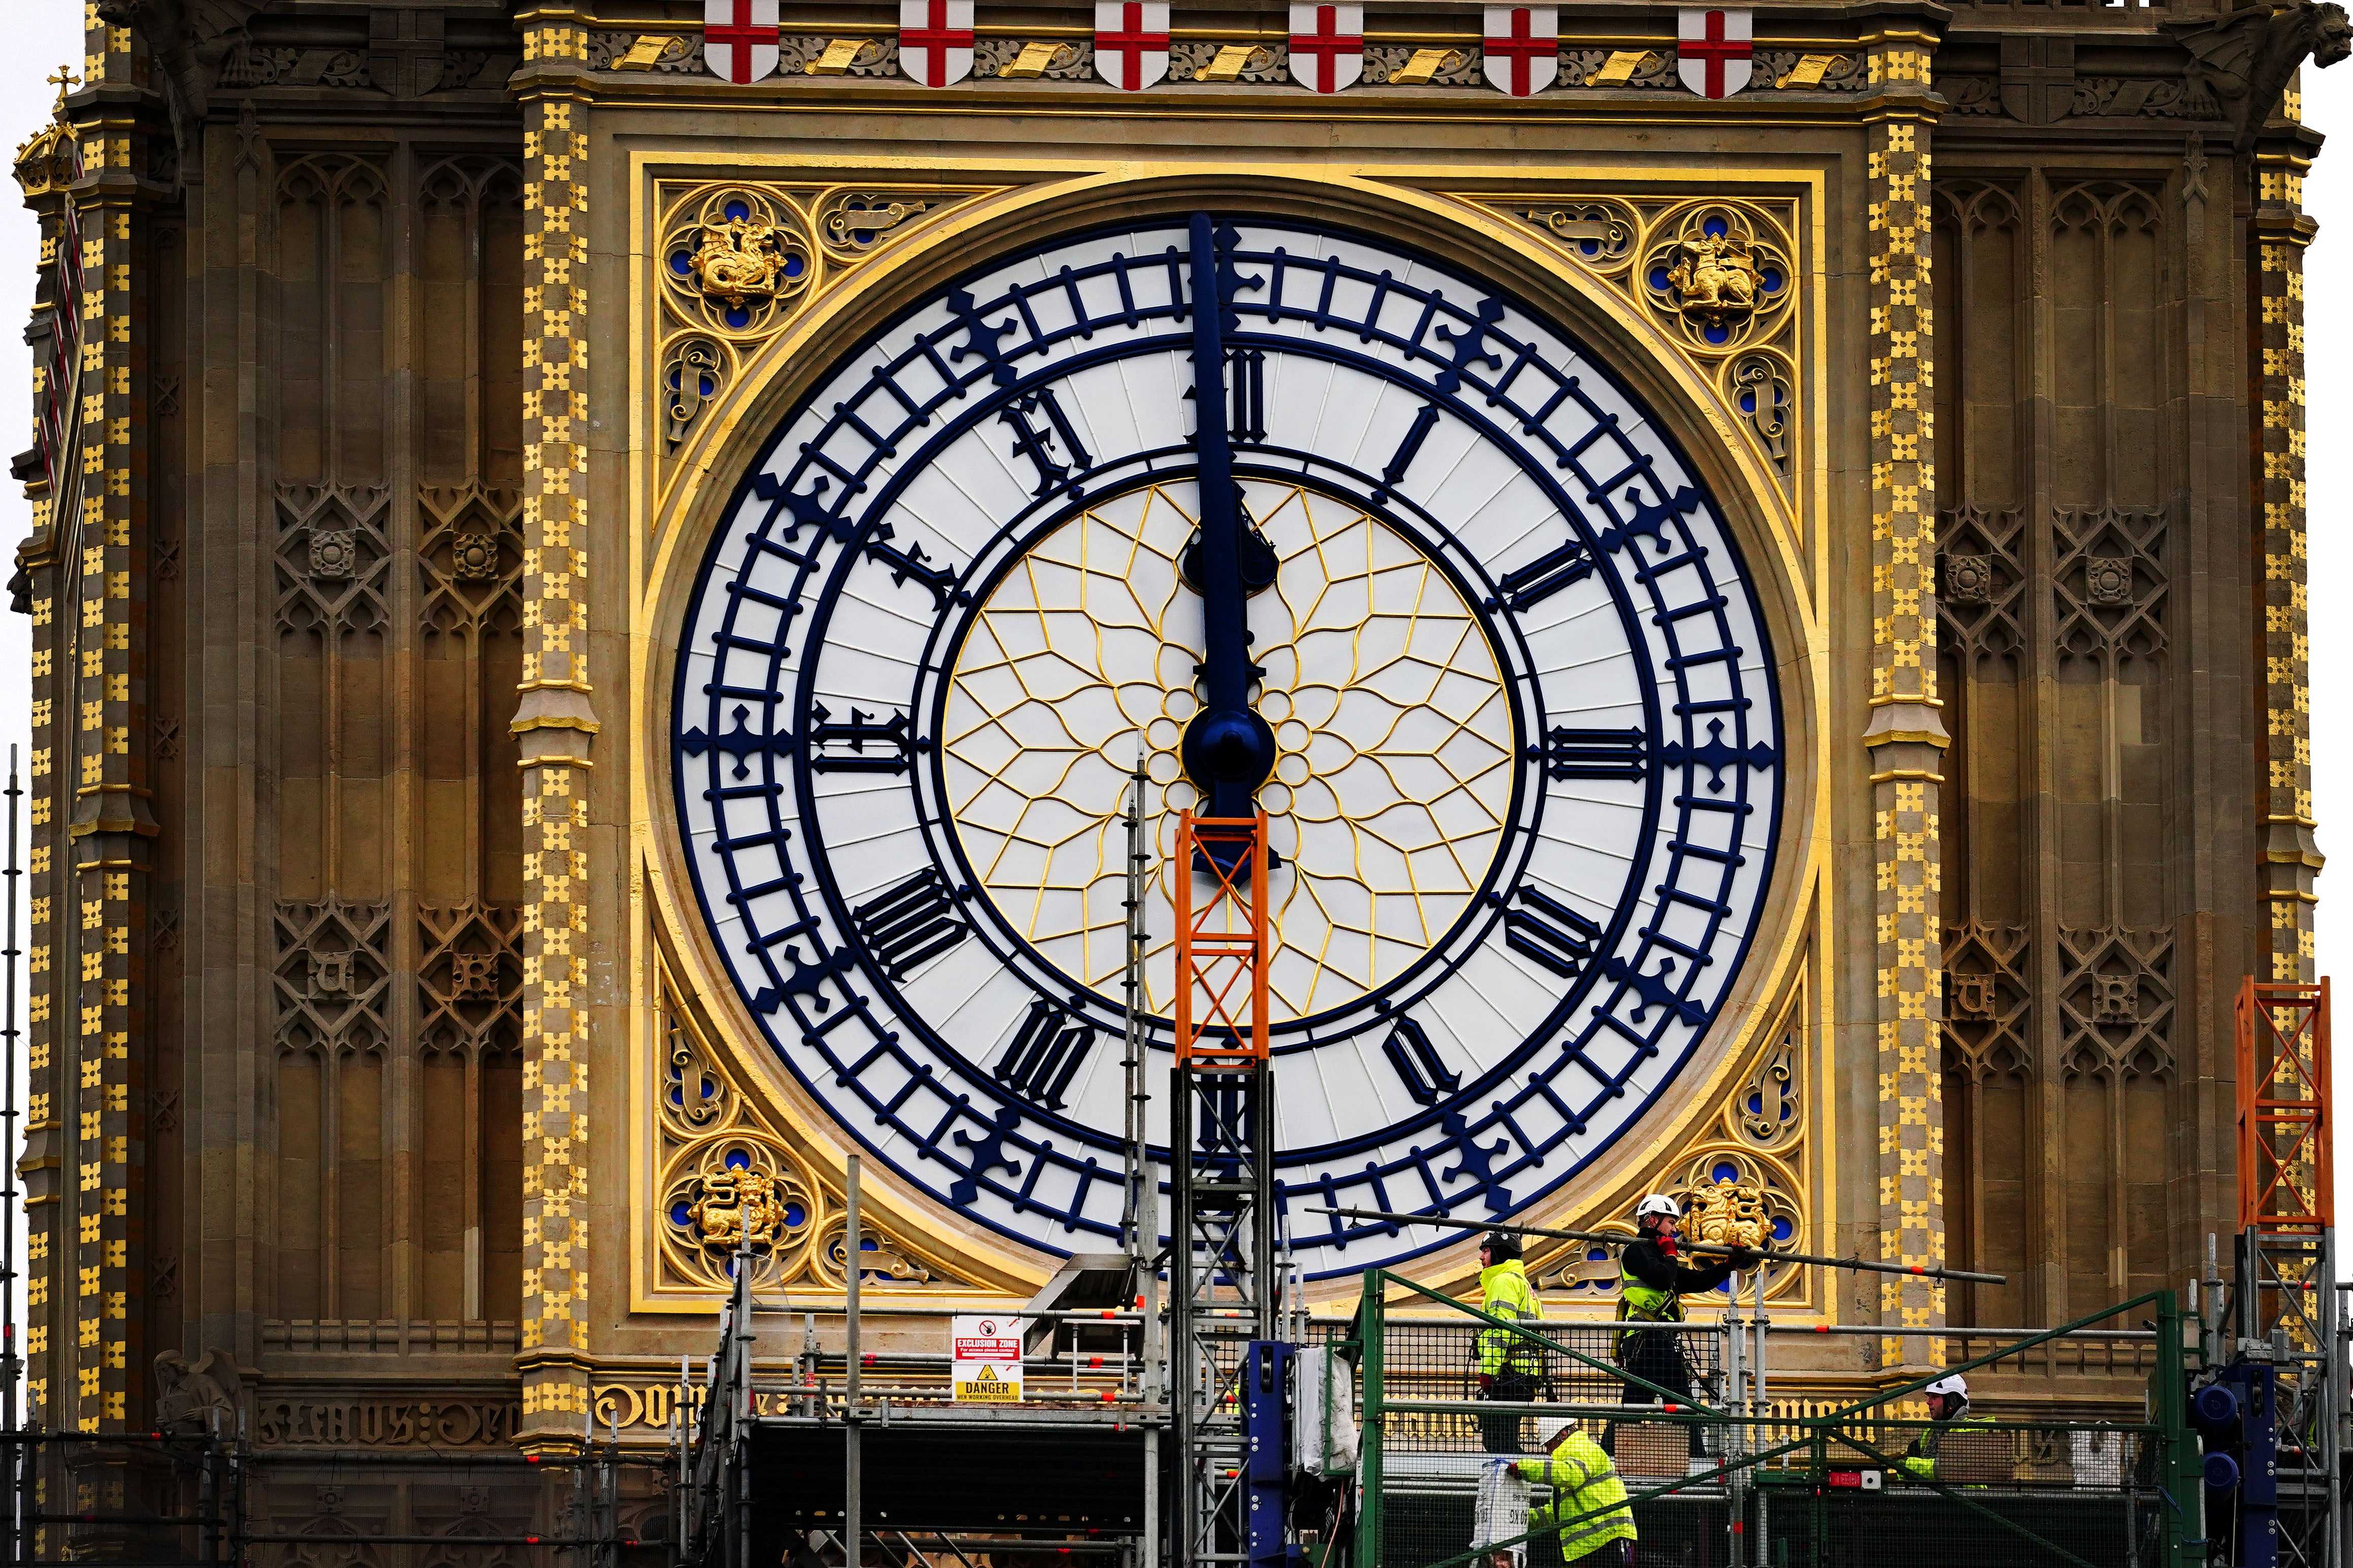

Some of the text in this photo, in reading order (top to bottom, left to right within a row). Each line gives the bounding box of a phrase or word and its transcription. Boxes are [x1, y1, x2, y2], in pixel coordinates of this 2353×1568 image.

[1382, 402, 1440, 487] I
[1496, 538, 1595, 614] II
[1547, 724, 1647, 784] III
[957, 1339, 1018, 1348] EXCLUSION ZONE
[966, 1382, 1009, 1393] DANGER
